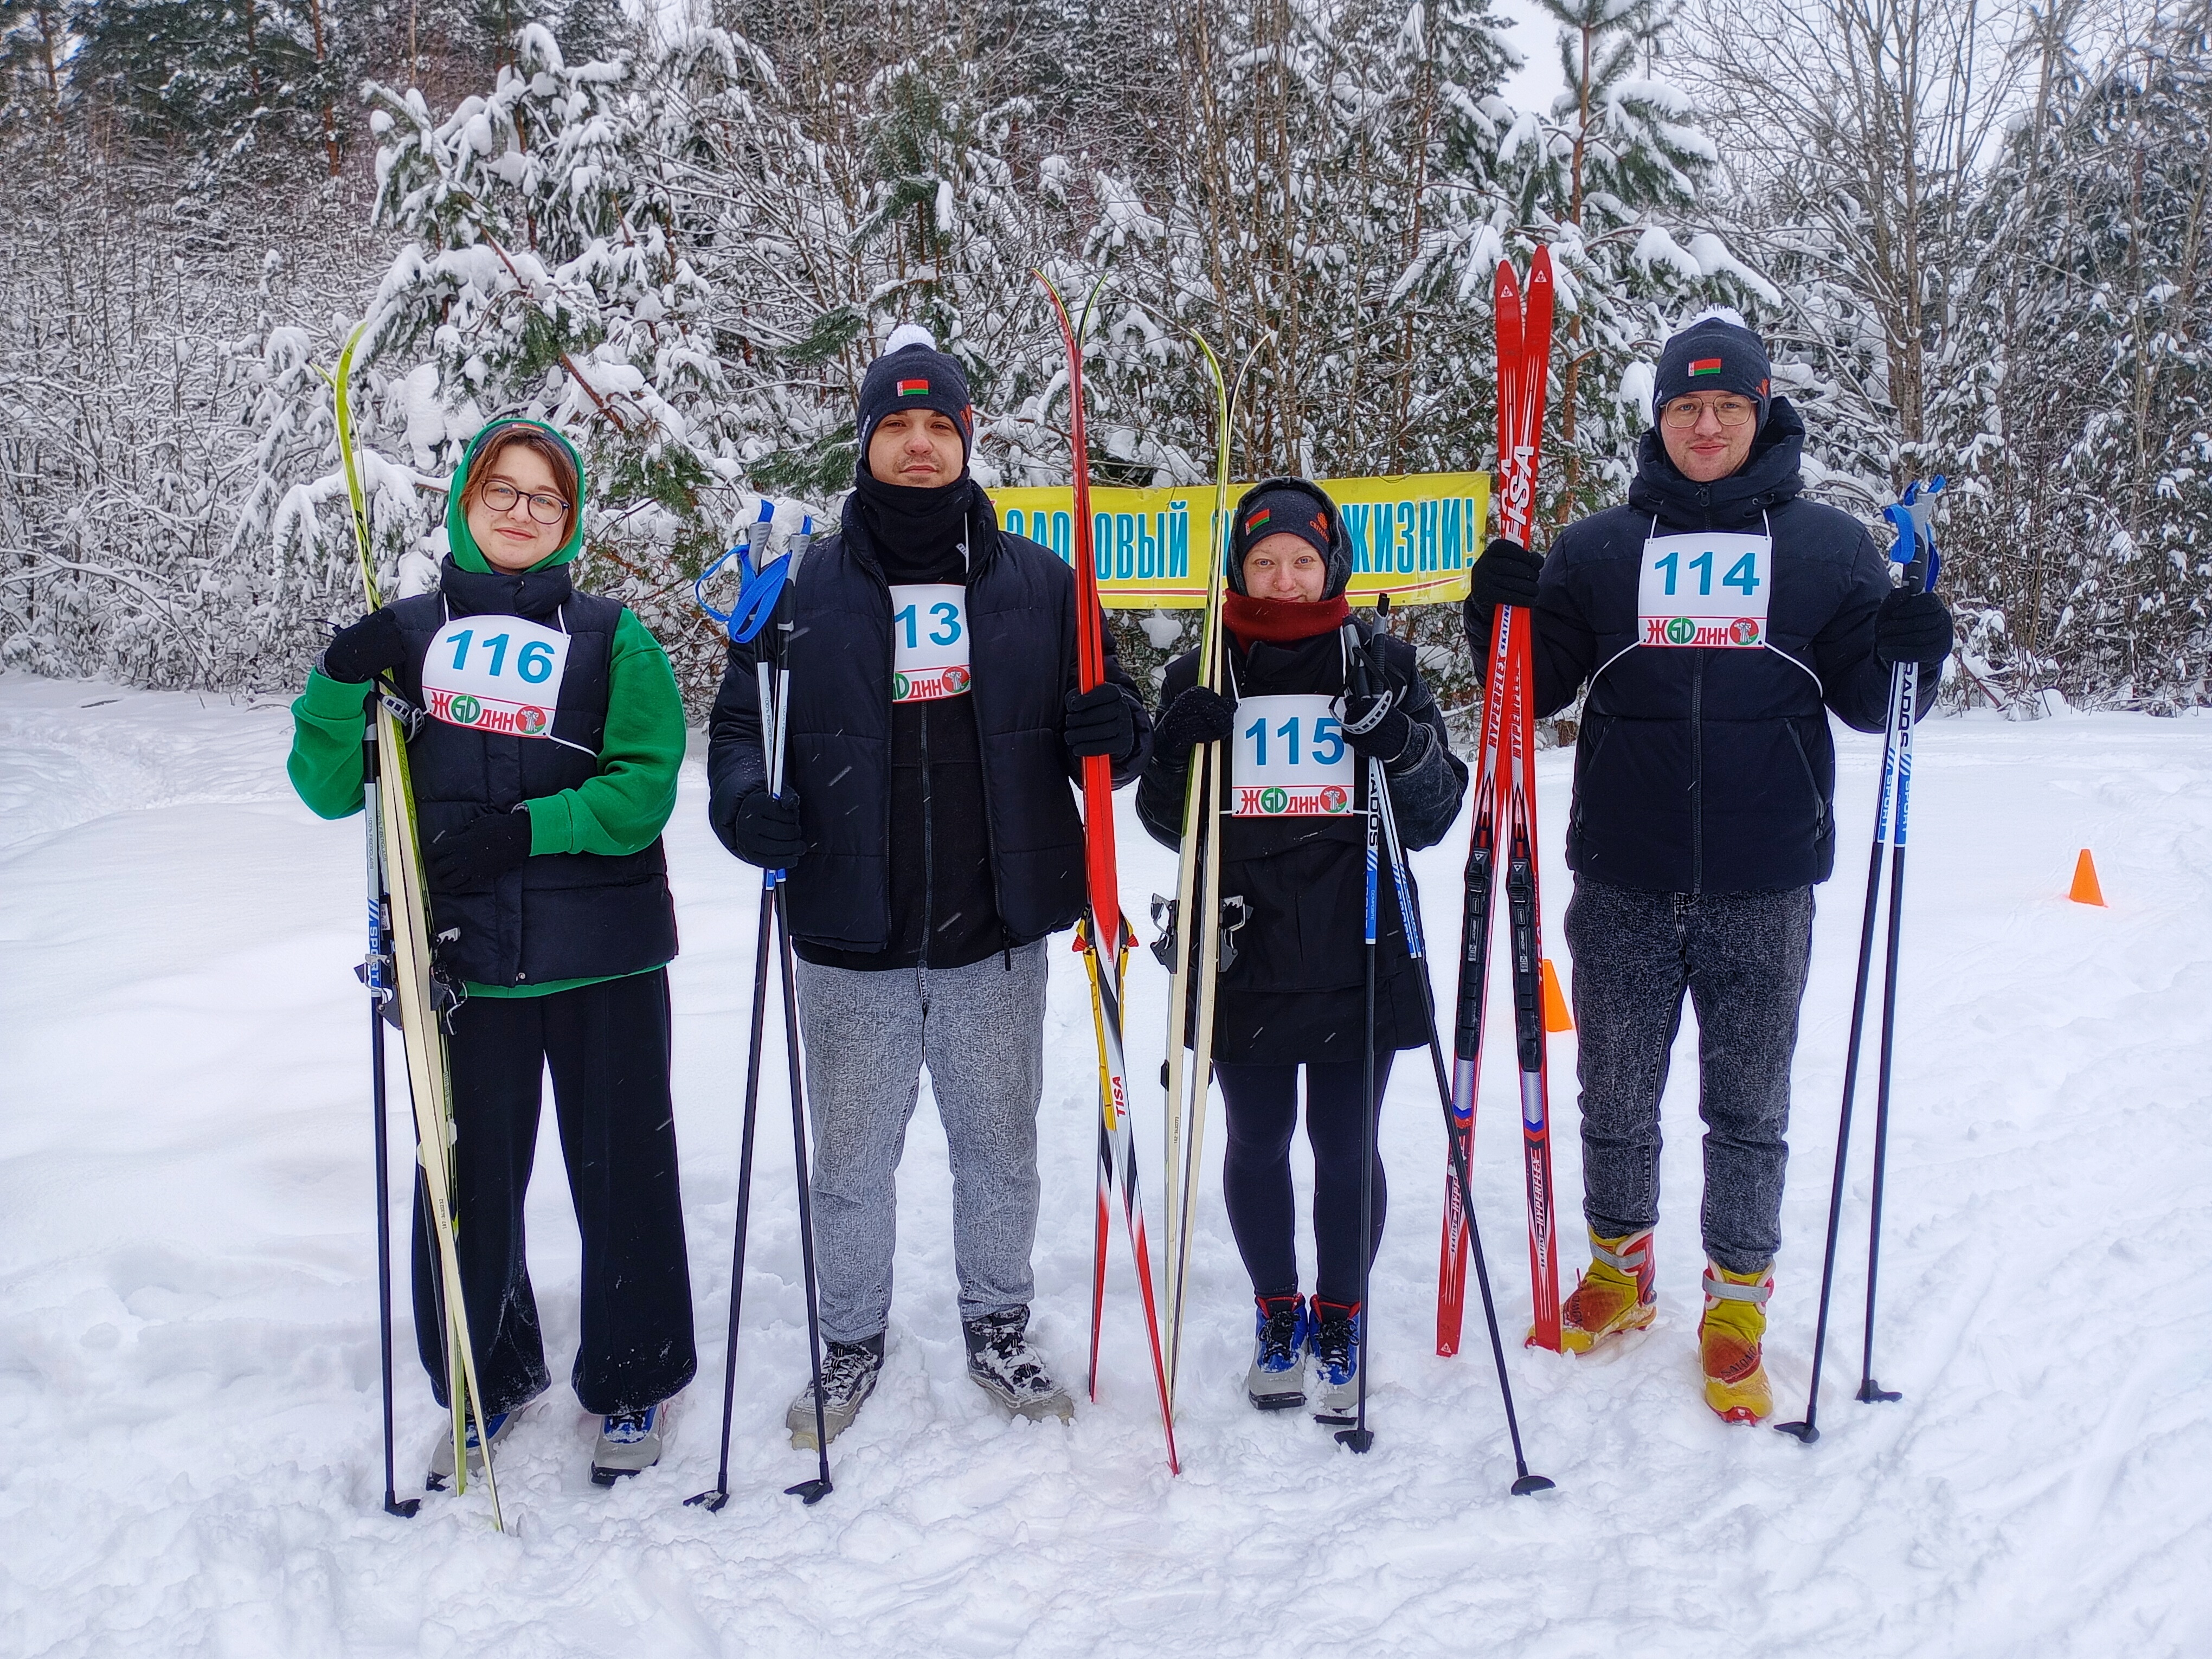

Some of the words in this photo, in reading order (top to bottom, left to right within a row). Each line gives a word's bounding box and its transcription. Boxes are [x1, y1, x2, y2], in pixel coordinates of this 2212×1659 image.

[1006, 500, 1189, 580] ООВЫЙ
[1341, 497, 1474, 574] ЖИЗНИ!
[1654, 551, 1760, 596] 114
[894, 602, 962, 648] 13
[446, 629, 555, 684] 116
[1488, 654, 1506, 749] HYPERFLEX
[1245, 716, 1346, 766] 115
[1112, 1076, 1126, 1118] TISA
[1532, 1156, 1544, 1226] HYPERFLEX
